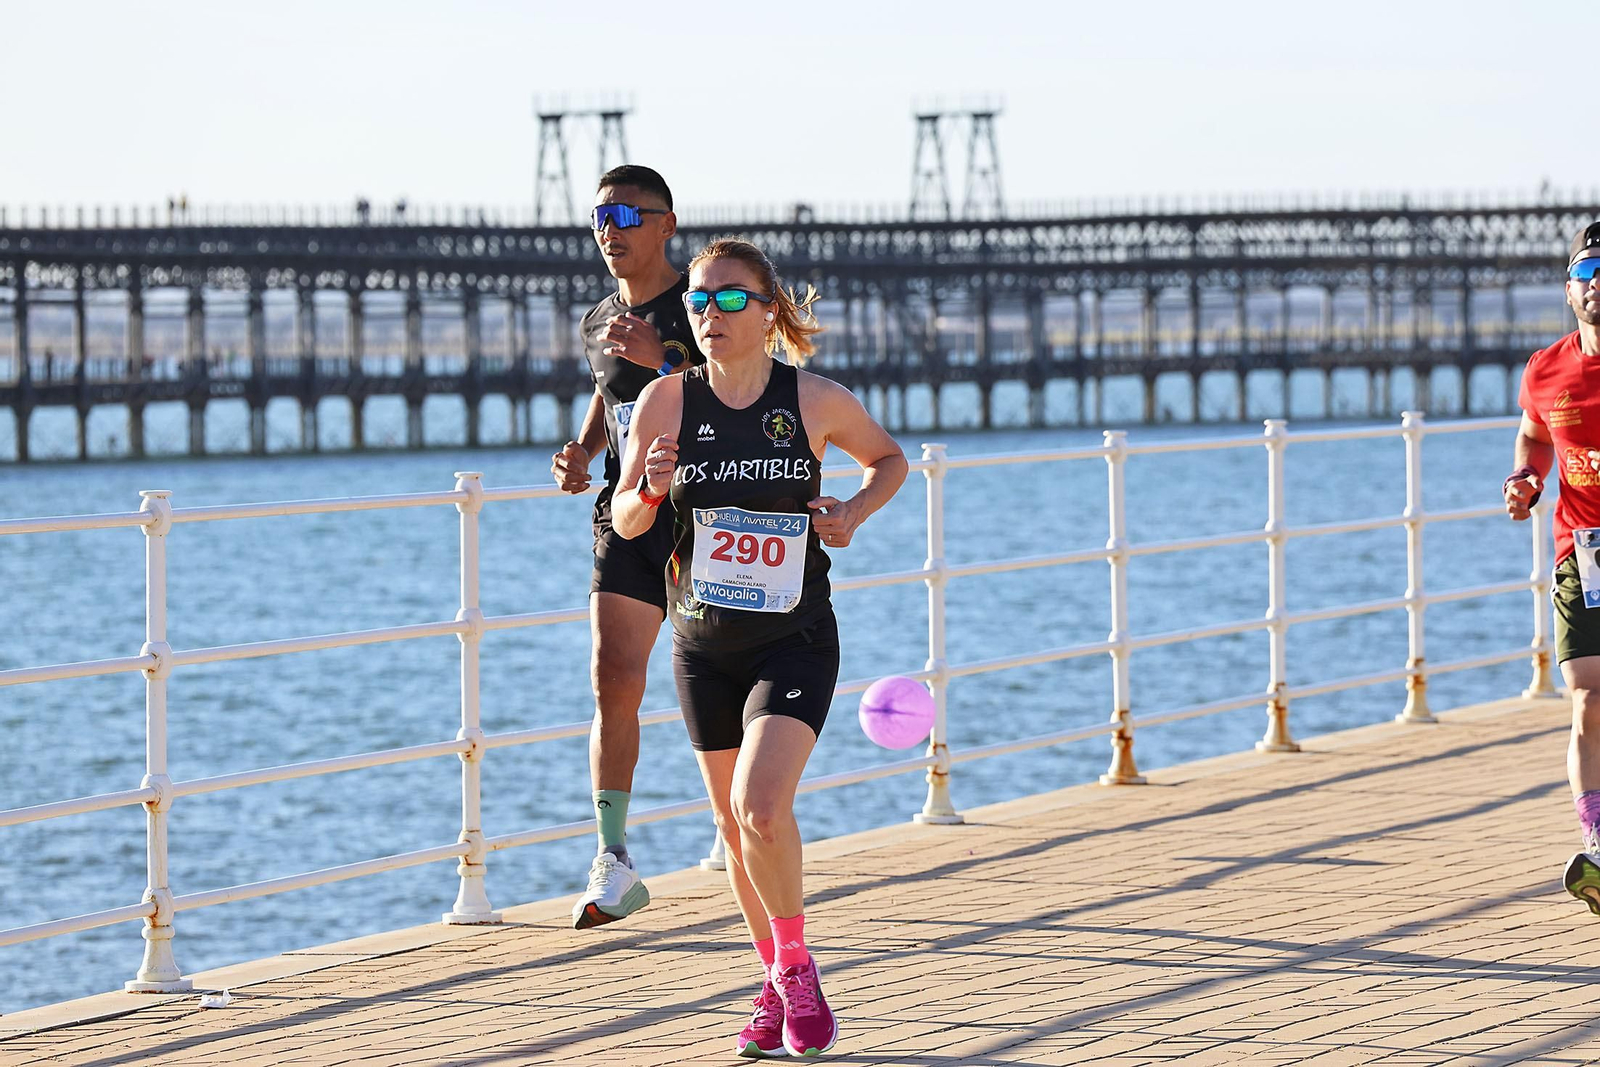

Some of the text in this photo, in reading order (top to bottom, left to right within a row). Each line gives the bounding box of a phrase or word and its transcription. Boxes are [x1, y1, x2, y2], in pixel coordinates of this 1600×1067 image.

[674, 457, 812, 486] LOS JARTIBLES
[717, 512, 740, 523] HUELVA
[742, 516, 779, 527] AVATEL
[779, 518, 802, 533] '24
[710, 531, 786, 567] 290
[707, 583, 758, 601] Wayalia
[721, 578, 746, 587] CAMACHO
